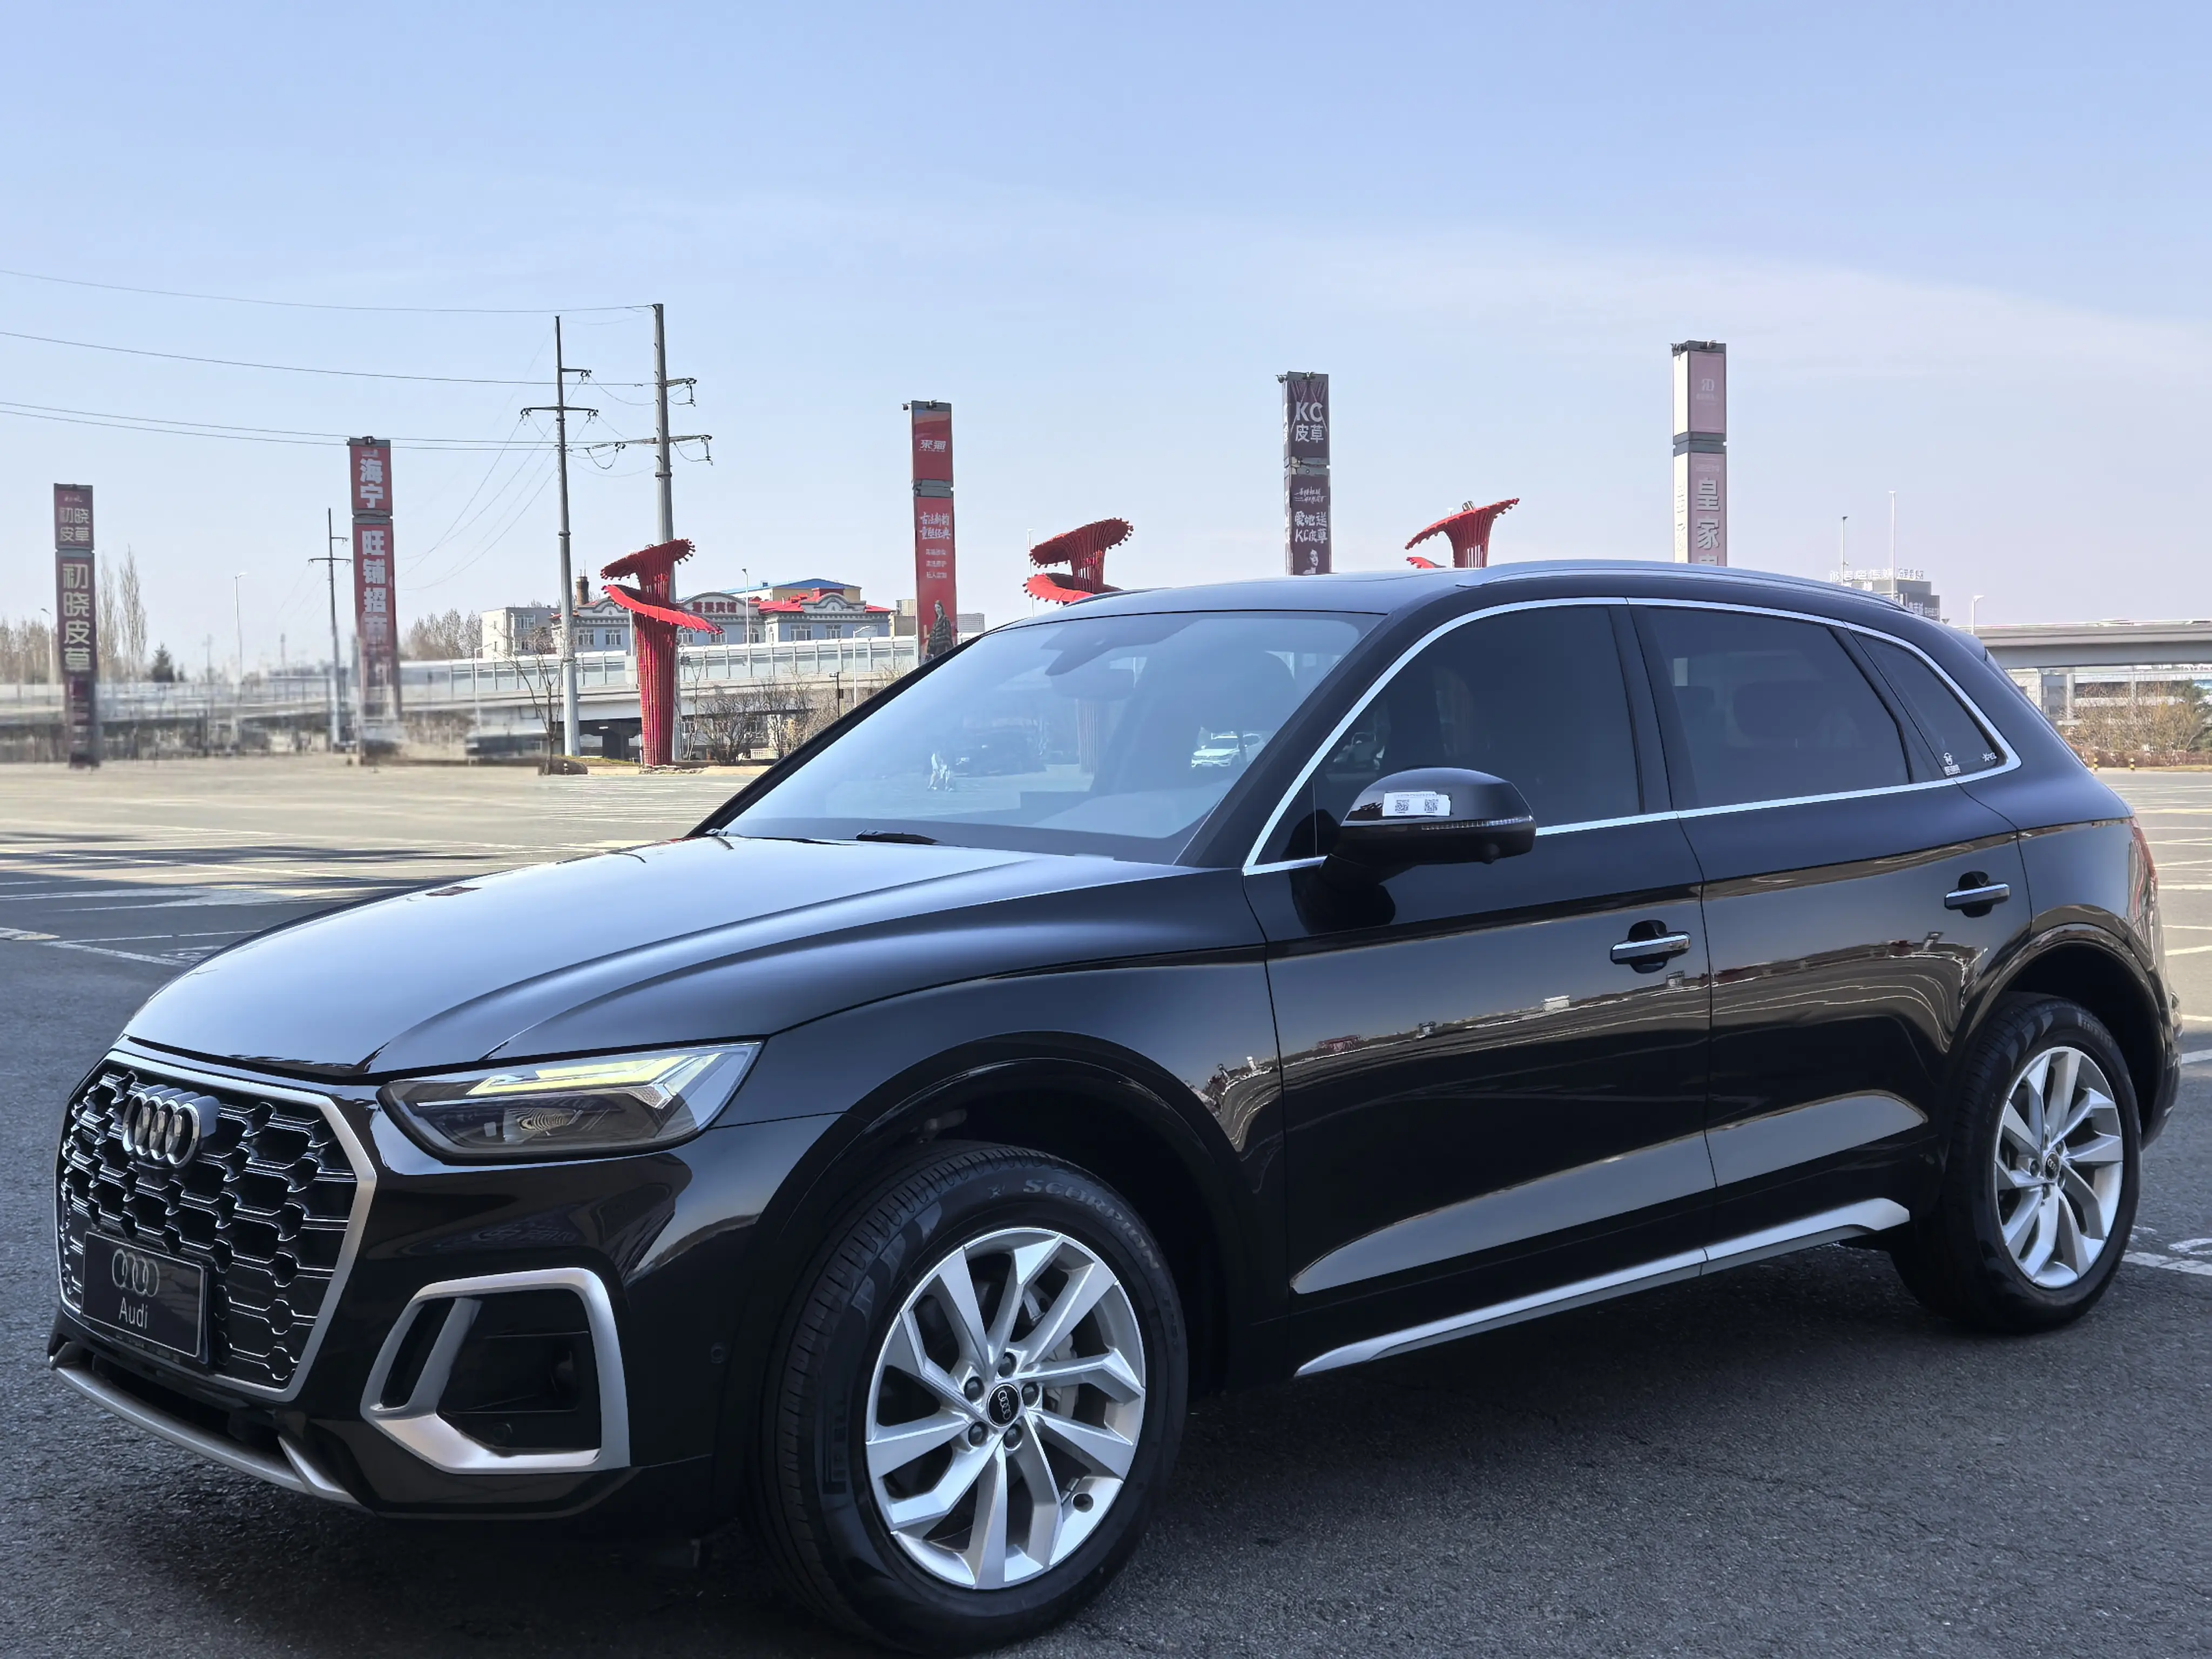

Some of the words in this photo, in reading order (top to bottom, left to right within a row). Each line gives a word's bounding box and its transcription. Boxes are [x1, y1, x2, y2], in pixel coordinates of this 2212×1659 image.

[1296, 401, 1323, 422] KC
[1295, 423, 1324, 443] 皮草
[360, 458, 384, 509] 海宁
[59, 507, 90, 524] 初晓
[60, 526, 91, 542] 皮草
[62, 563, 91, 671] 初晓皮草
[1023, 1179, 1160, 1269] SCORPION
[118, 1296, 148, 1330] Audi
